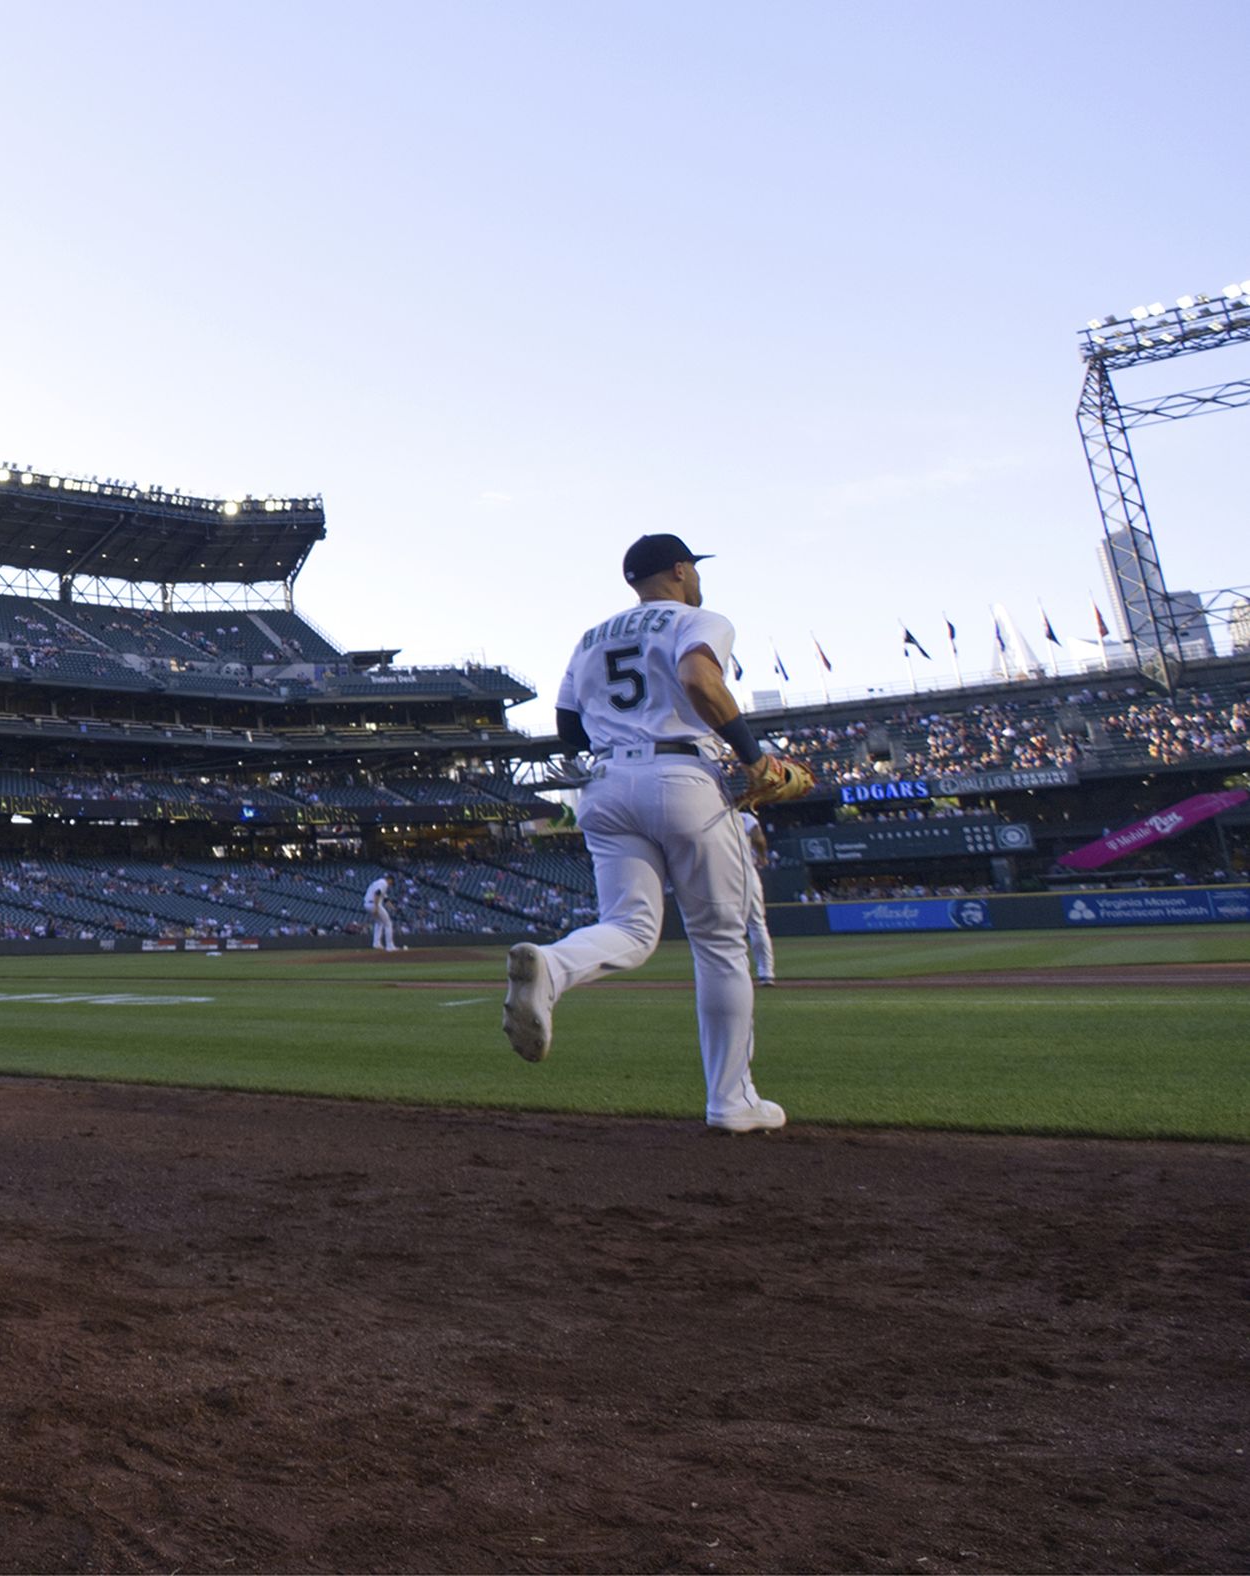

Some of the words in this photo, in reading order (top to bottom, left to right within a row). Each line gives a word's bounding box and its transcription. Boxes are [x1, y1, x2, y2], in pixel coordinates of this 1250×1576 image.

[581, 608, 676, 652] BAUERS
[603, 642, 648, 713] 5
[841, 780, 930, 804] EDGARS
[862, 904, 919, 920] Alaska
[1095, 898, 1143, 910] Virginia
[1143, 897, 1186, 907] Mason
[1099, 907, 1165, 919] Franciscan
[1164, 906, 1210, 917] Health
